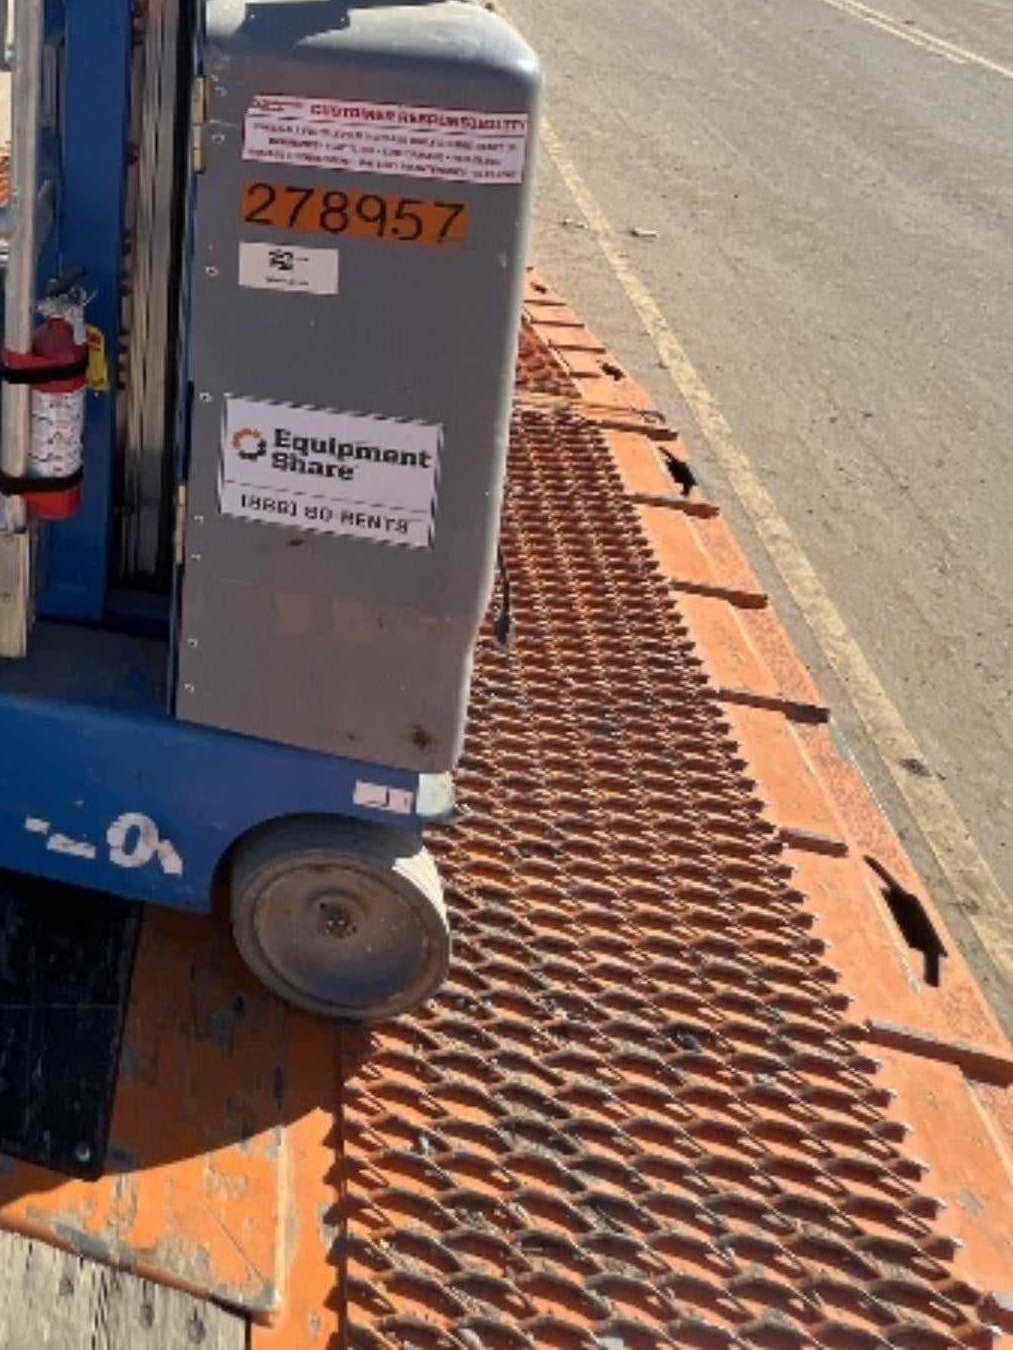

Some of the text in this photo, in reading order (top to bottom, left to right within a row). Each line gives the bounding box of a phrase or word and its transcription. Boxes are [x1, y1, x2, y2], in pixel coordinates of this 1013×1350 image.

[244, 181, 465, 243] 278957
[271, 452, 355, 481] Share
[273, 427, 432, 470] Equipment
